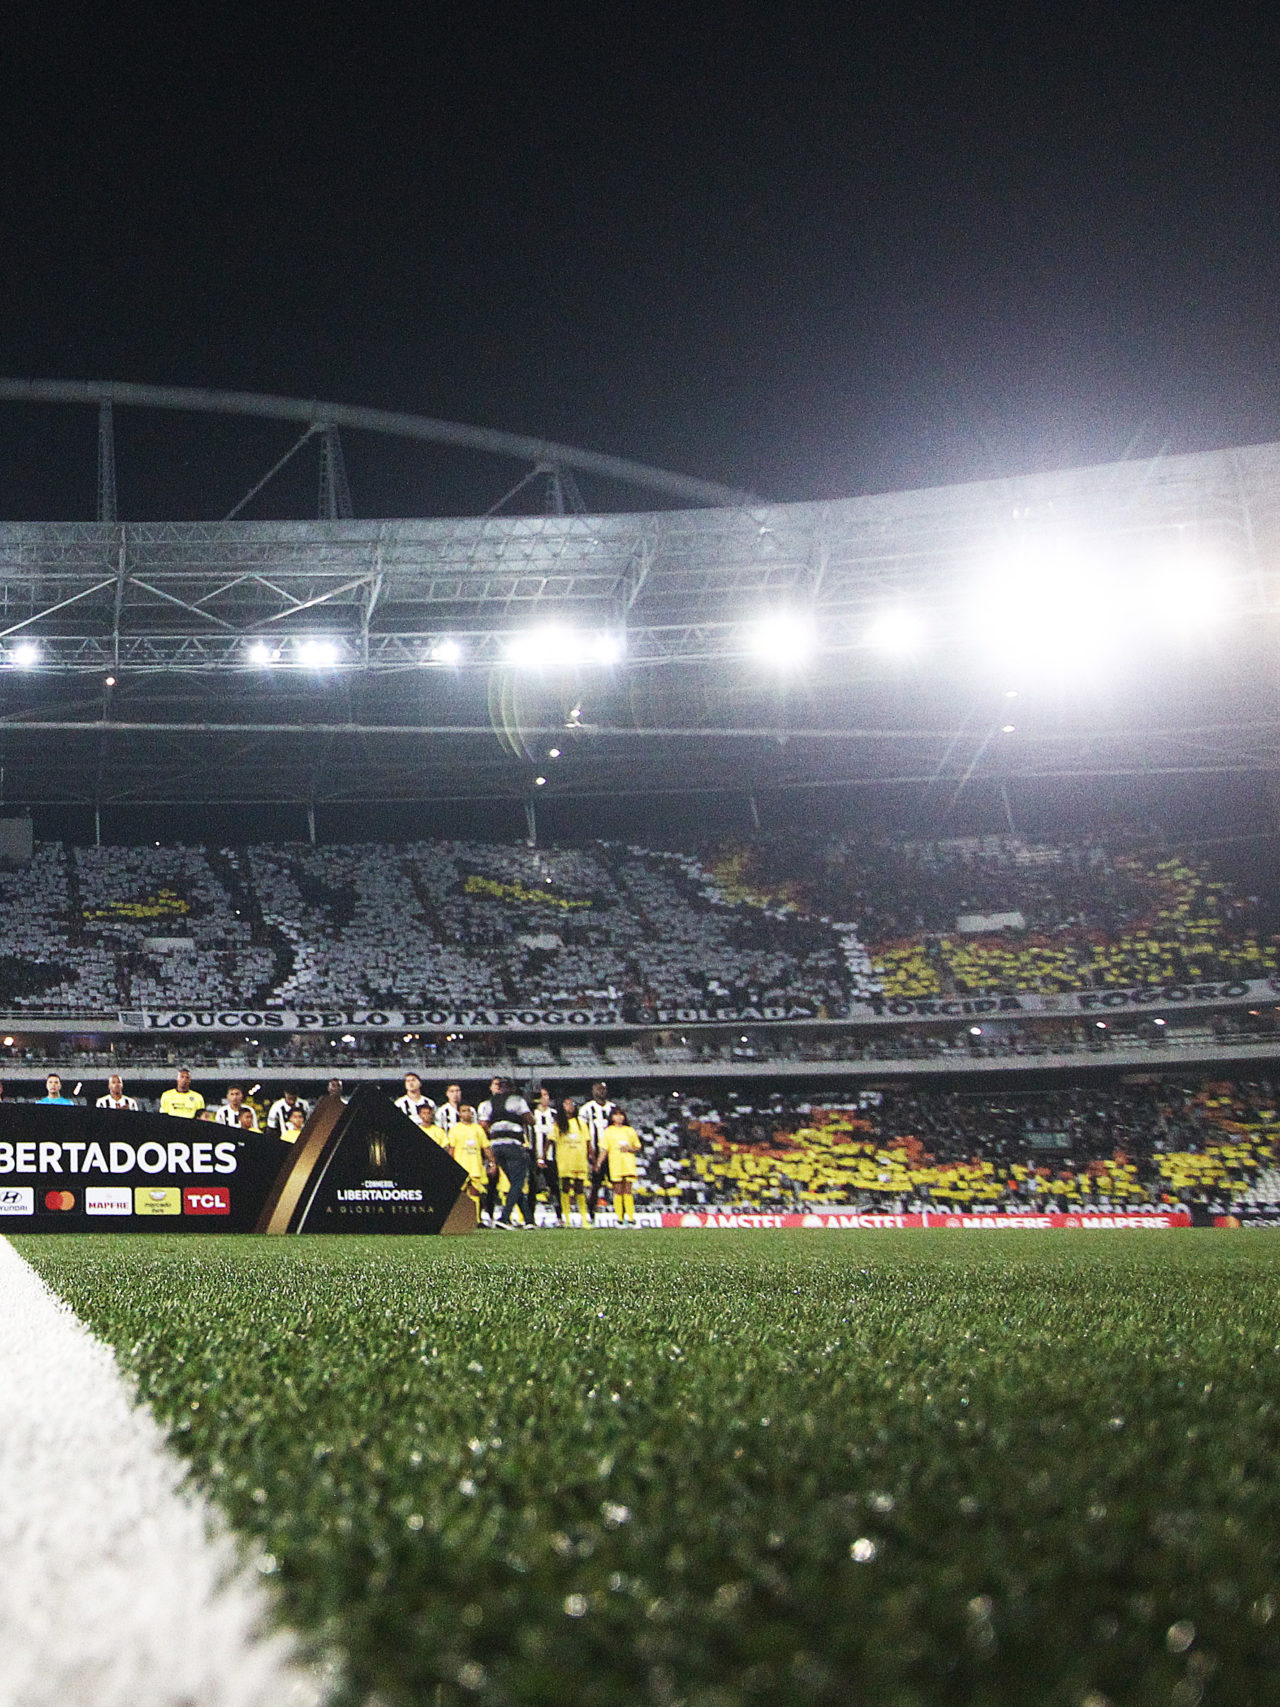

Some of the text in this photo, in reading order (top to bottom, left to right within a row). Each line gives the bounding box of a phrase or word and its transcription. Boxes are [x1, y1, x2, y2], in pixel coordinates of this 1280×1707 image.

[148, 1011, 591, 1028] LOUCOS PELO BOTAFOGO
[187, 1195, 226, 1208] TCL
[337, 1189, 423, 1201] LIBERTADORES
[704, 1214, 782, 1228] AMSTEL
[826, 1214, 904, 1228] AMSTEL
[962, 1217, 1051, 1229] MAPFRE
[1081, 1217, 1170, 1229] MAPFRE
